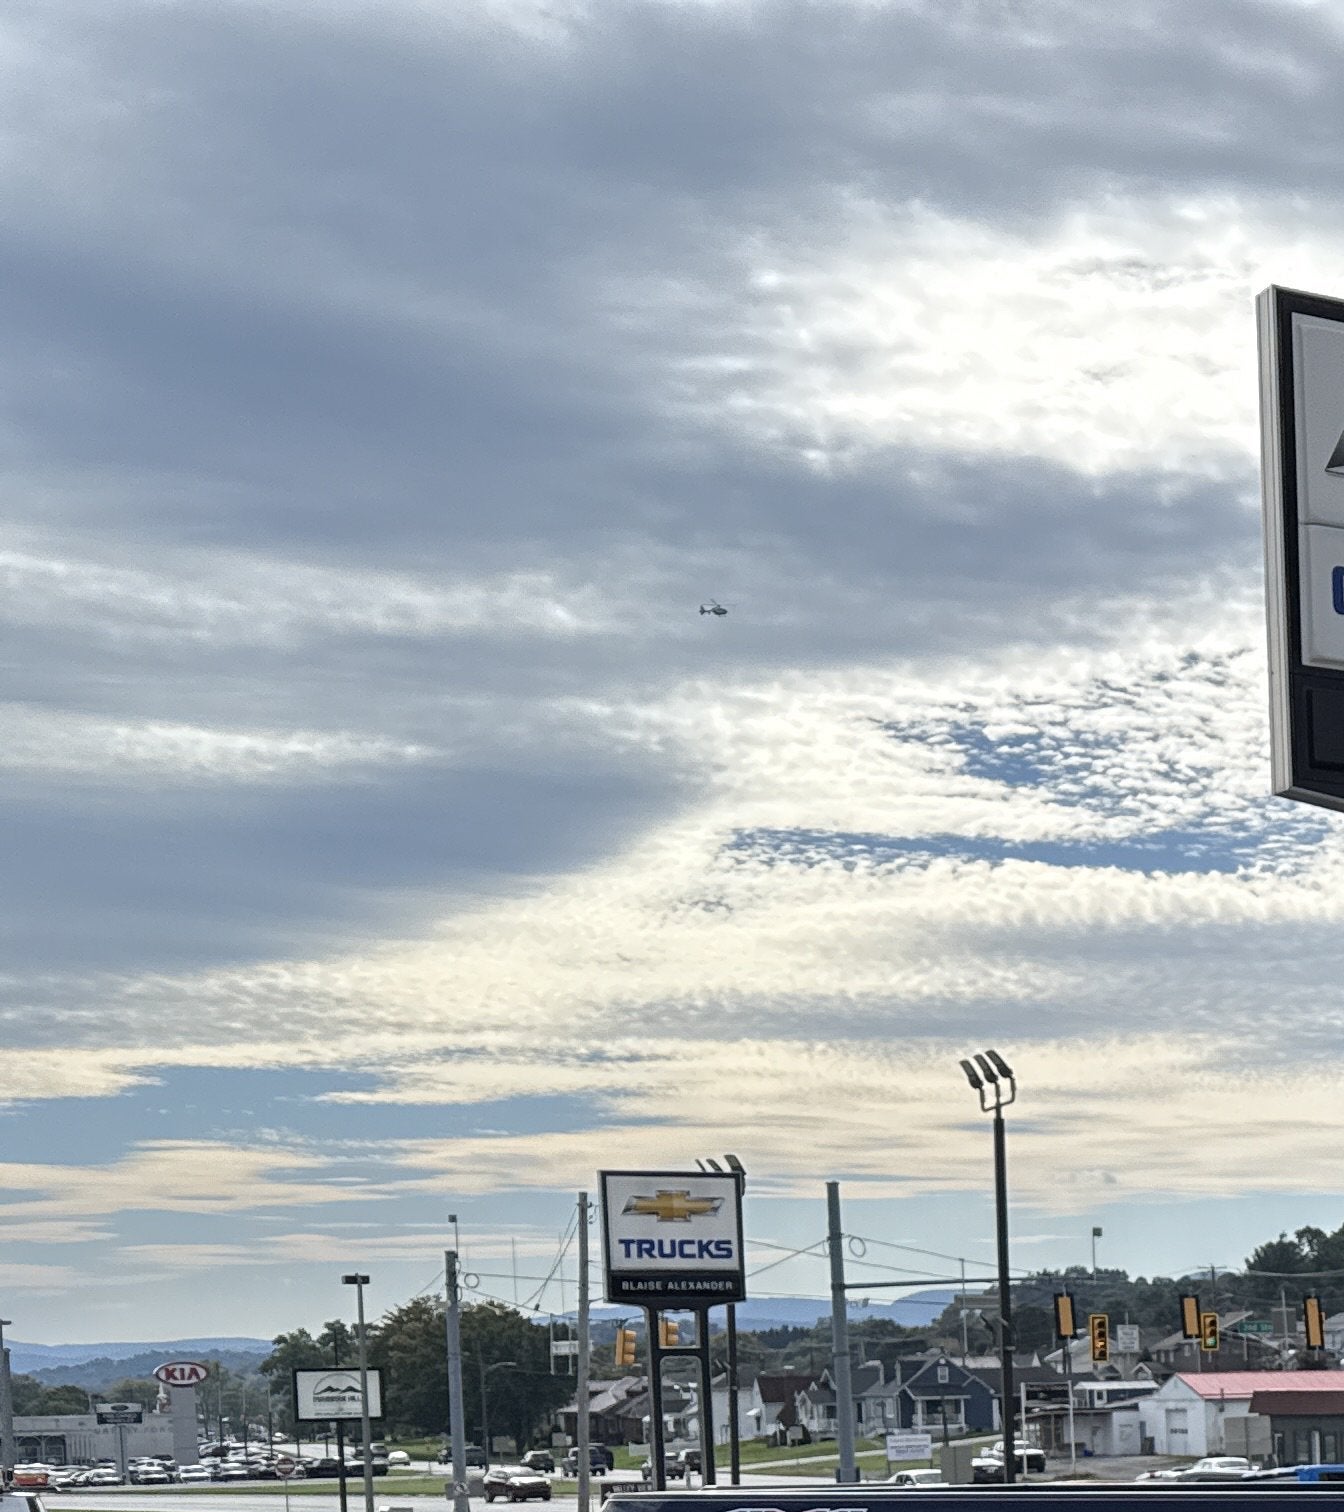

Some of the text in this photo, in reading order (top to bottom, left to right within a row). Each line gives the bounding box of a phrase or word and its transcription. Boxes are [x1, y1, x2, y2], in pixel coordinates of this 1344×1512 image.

[618, 1238, 733, 1259] TRUCKS
[621, 1280, 733, 1291] BLAISE ALEXANDER
[164, 1367, 200, 1381] KIA
